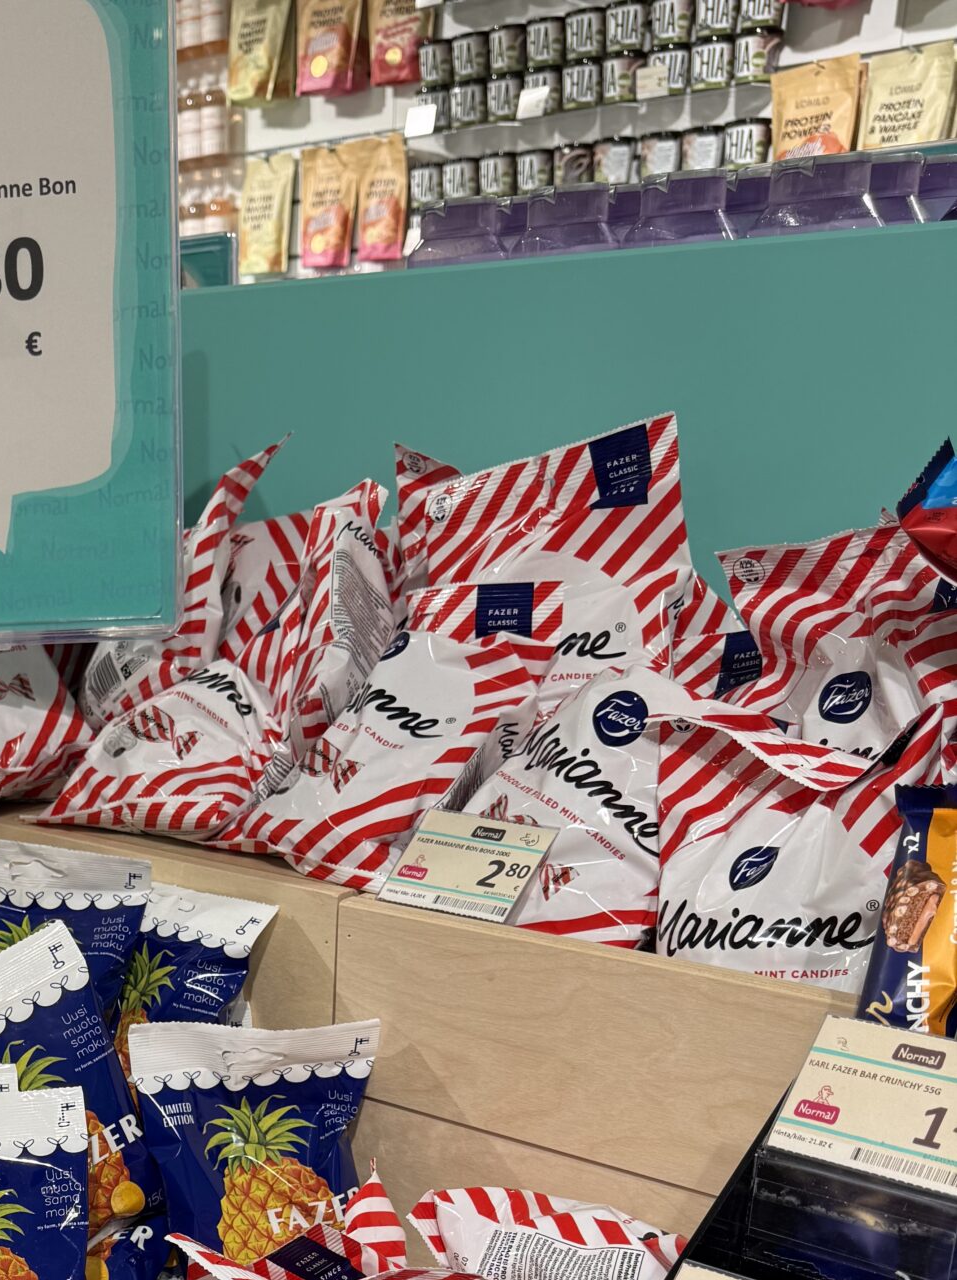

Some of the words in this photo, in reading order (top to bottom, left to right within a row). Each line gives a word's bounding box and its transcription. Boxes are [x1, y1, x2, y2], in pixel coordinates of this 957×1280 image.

[39, 177, 77, 196] Bon
[25, 331, 43, 356] €
[606, 454, 638, 469] FAZER
[608, 464, 639, 479] CLASSIC
[488, 607, 519, 617] FAZER
[487, 618, 518, 627] CLASSIC
[474, 827, 504, 840] Normal
[400, 865, 426, 879] Normal
[101, 915, 126, 925] Uusi
[93, 923, 132, 935] muoto,
[657, 899, 876, 957] Marianne
[93, 932, 126, 942] sama
[92, 939, 124, 953] maku.
[196, 959, 223, 973] Uusi
[60, 1004, 89, 1025] Uusi
[62, 1013, 102, 1039] muoto,
[70, 1024, 102, 1048] sama
[76, 1037, 109, 1059] maku.
[898, 1047, 941, 1066] Normal
[809, 1058, 830, 1070] KARL
[832, 1064, 858, 1076] FAZER
[860, 1070, 878, 1081] BAR
[879, 1075, 923, 1091] CRUNCHY
[923, 1085, 942, 1096] 55G
[327, 1090, 354, 1103] Uusi
[798, 1103, 836, 1121] Normal
[44, 1167, 75, 1182] Uusi
